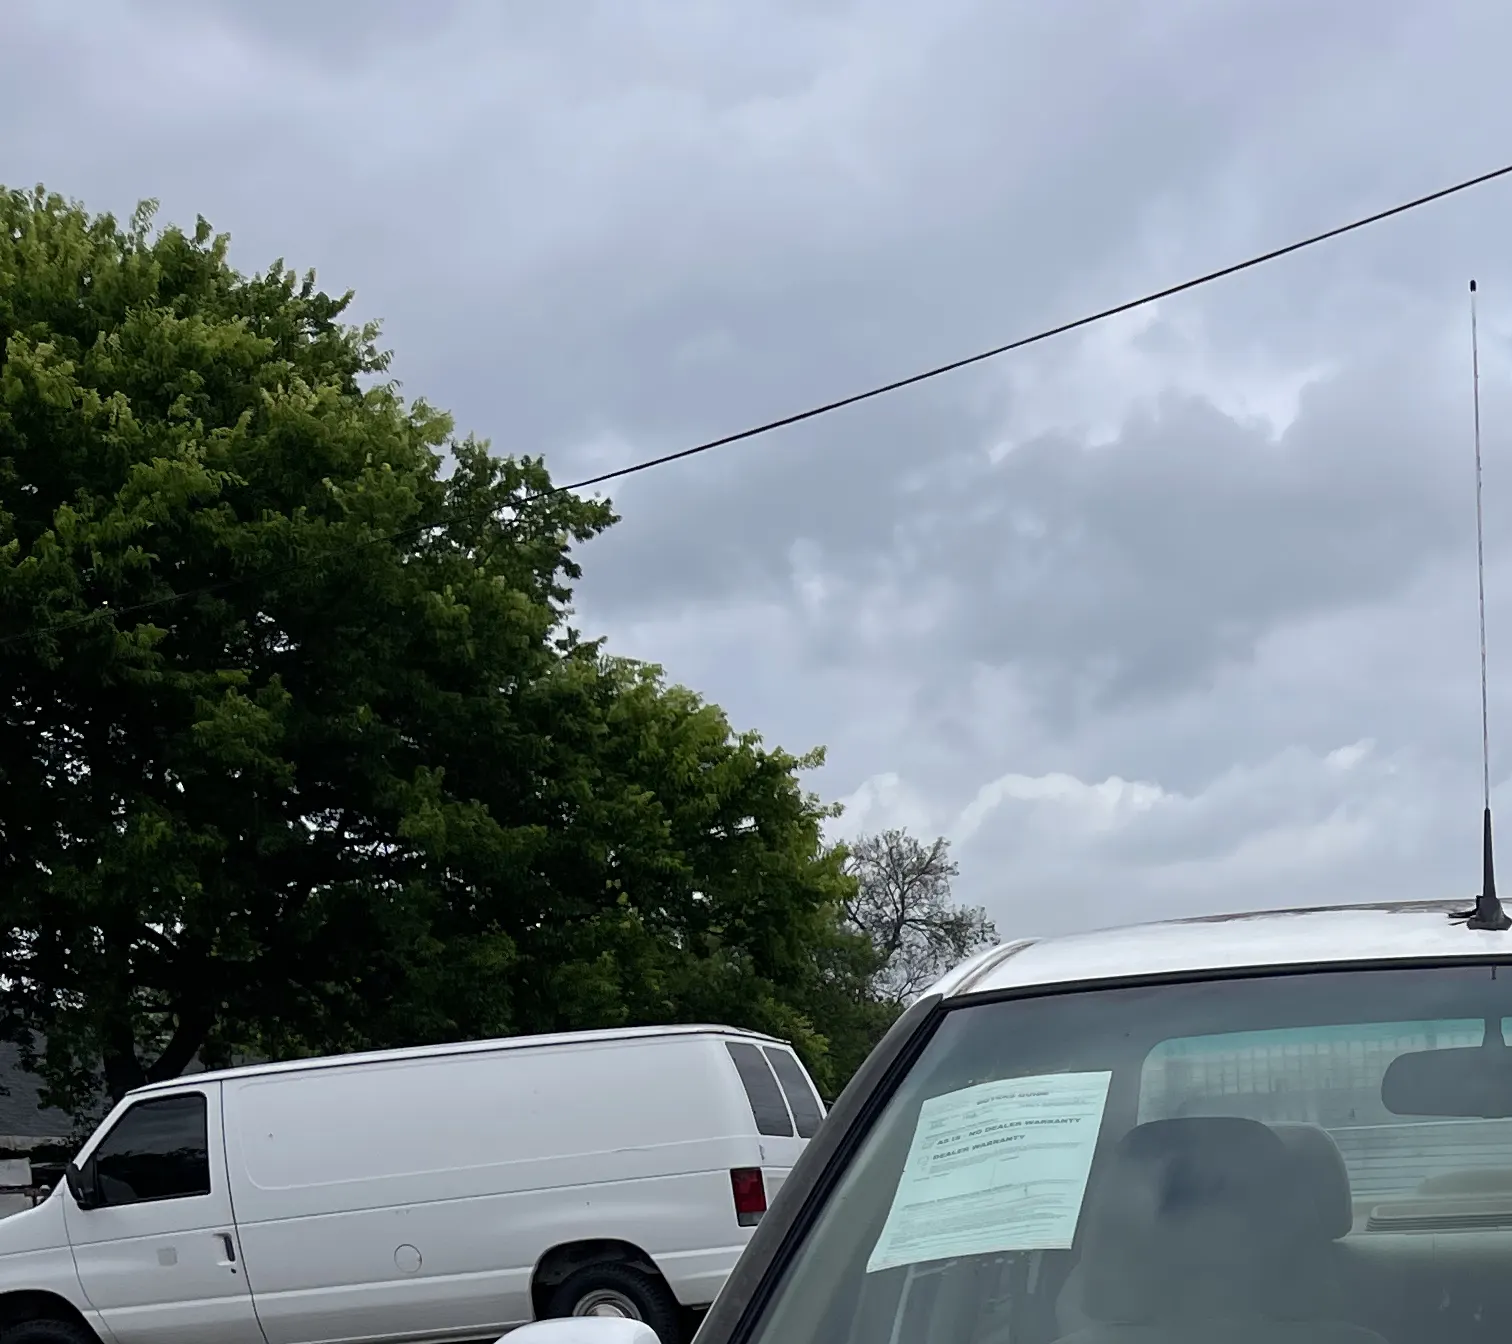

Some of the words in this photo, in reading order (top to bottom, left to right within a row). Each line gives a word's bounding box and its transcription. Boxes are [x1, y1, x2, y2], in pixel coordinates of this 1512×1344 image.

[985, 1121, 1022, 1133] DEALER
[1024, 1117, 1082, 1126] WARRANTY
[932, 1146, 970, 1160] DEALER
[971, 1134, 1026, 1151] WARRANTY
